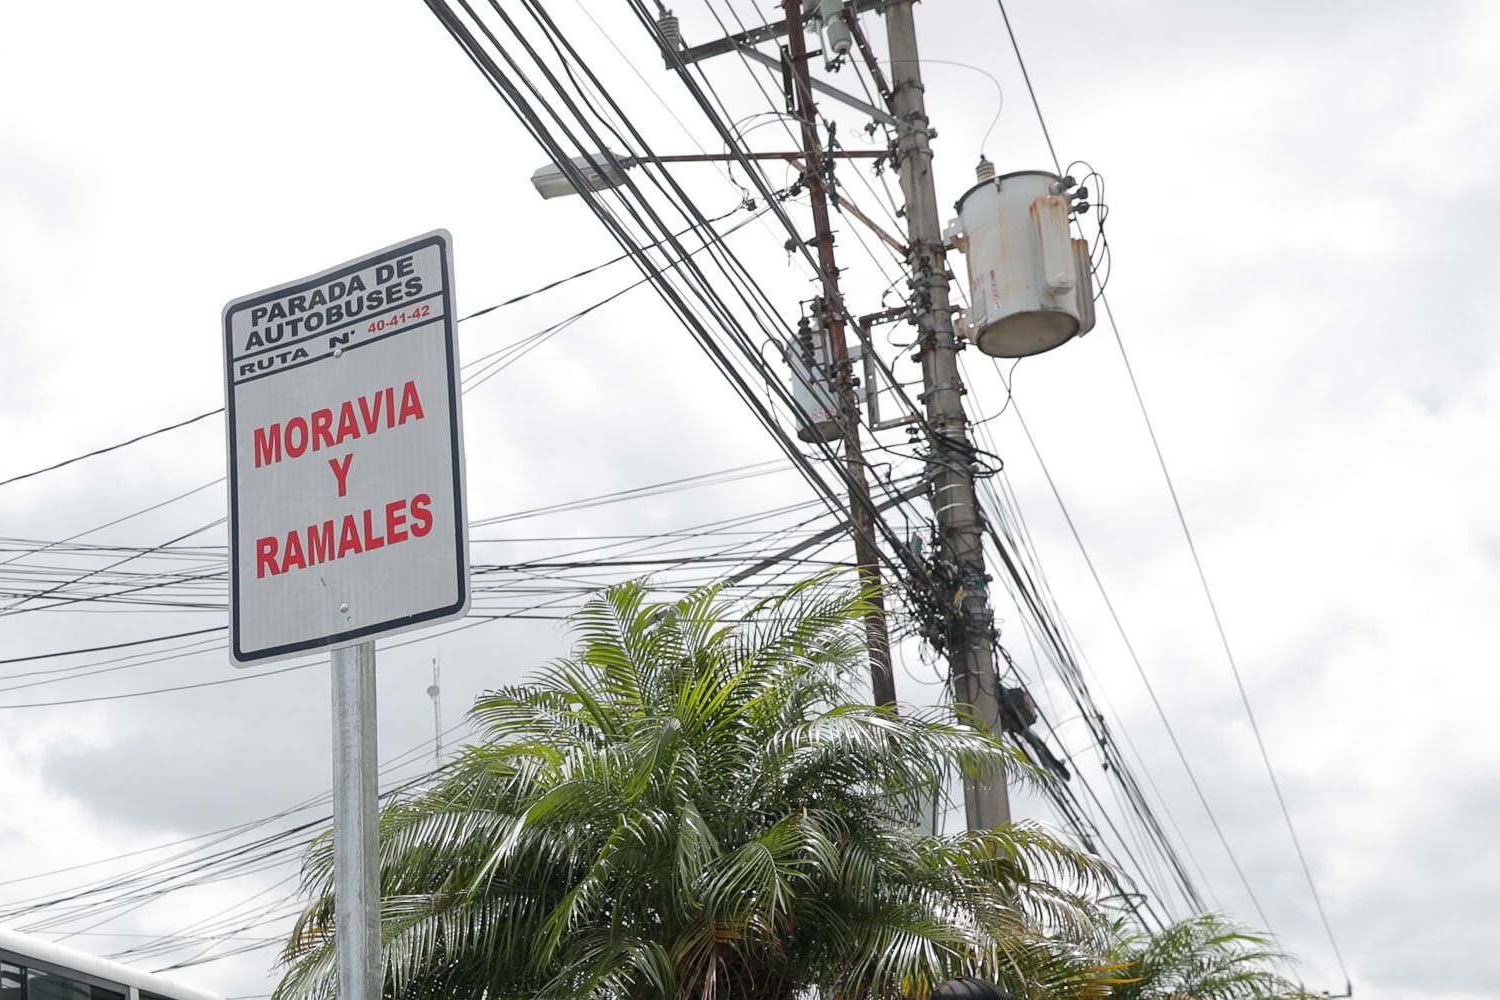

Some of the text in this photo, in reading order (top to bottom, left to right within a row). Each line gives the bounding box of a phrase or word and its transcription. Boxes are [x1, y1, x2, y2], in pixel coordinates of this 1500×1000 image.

[245, 277, 423, 351] AUTOBUSES
[252, 256, 414, 327] PARADA DE
[240, 347, 309, 376] RUTA
[367, 305, 430, 334] 40-41-42
[254, 380, 425, 468] MORAVIA
[328, 453, 354, 498] Y
[256, 493, 433, 579] RAMALES
